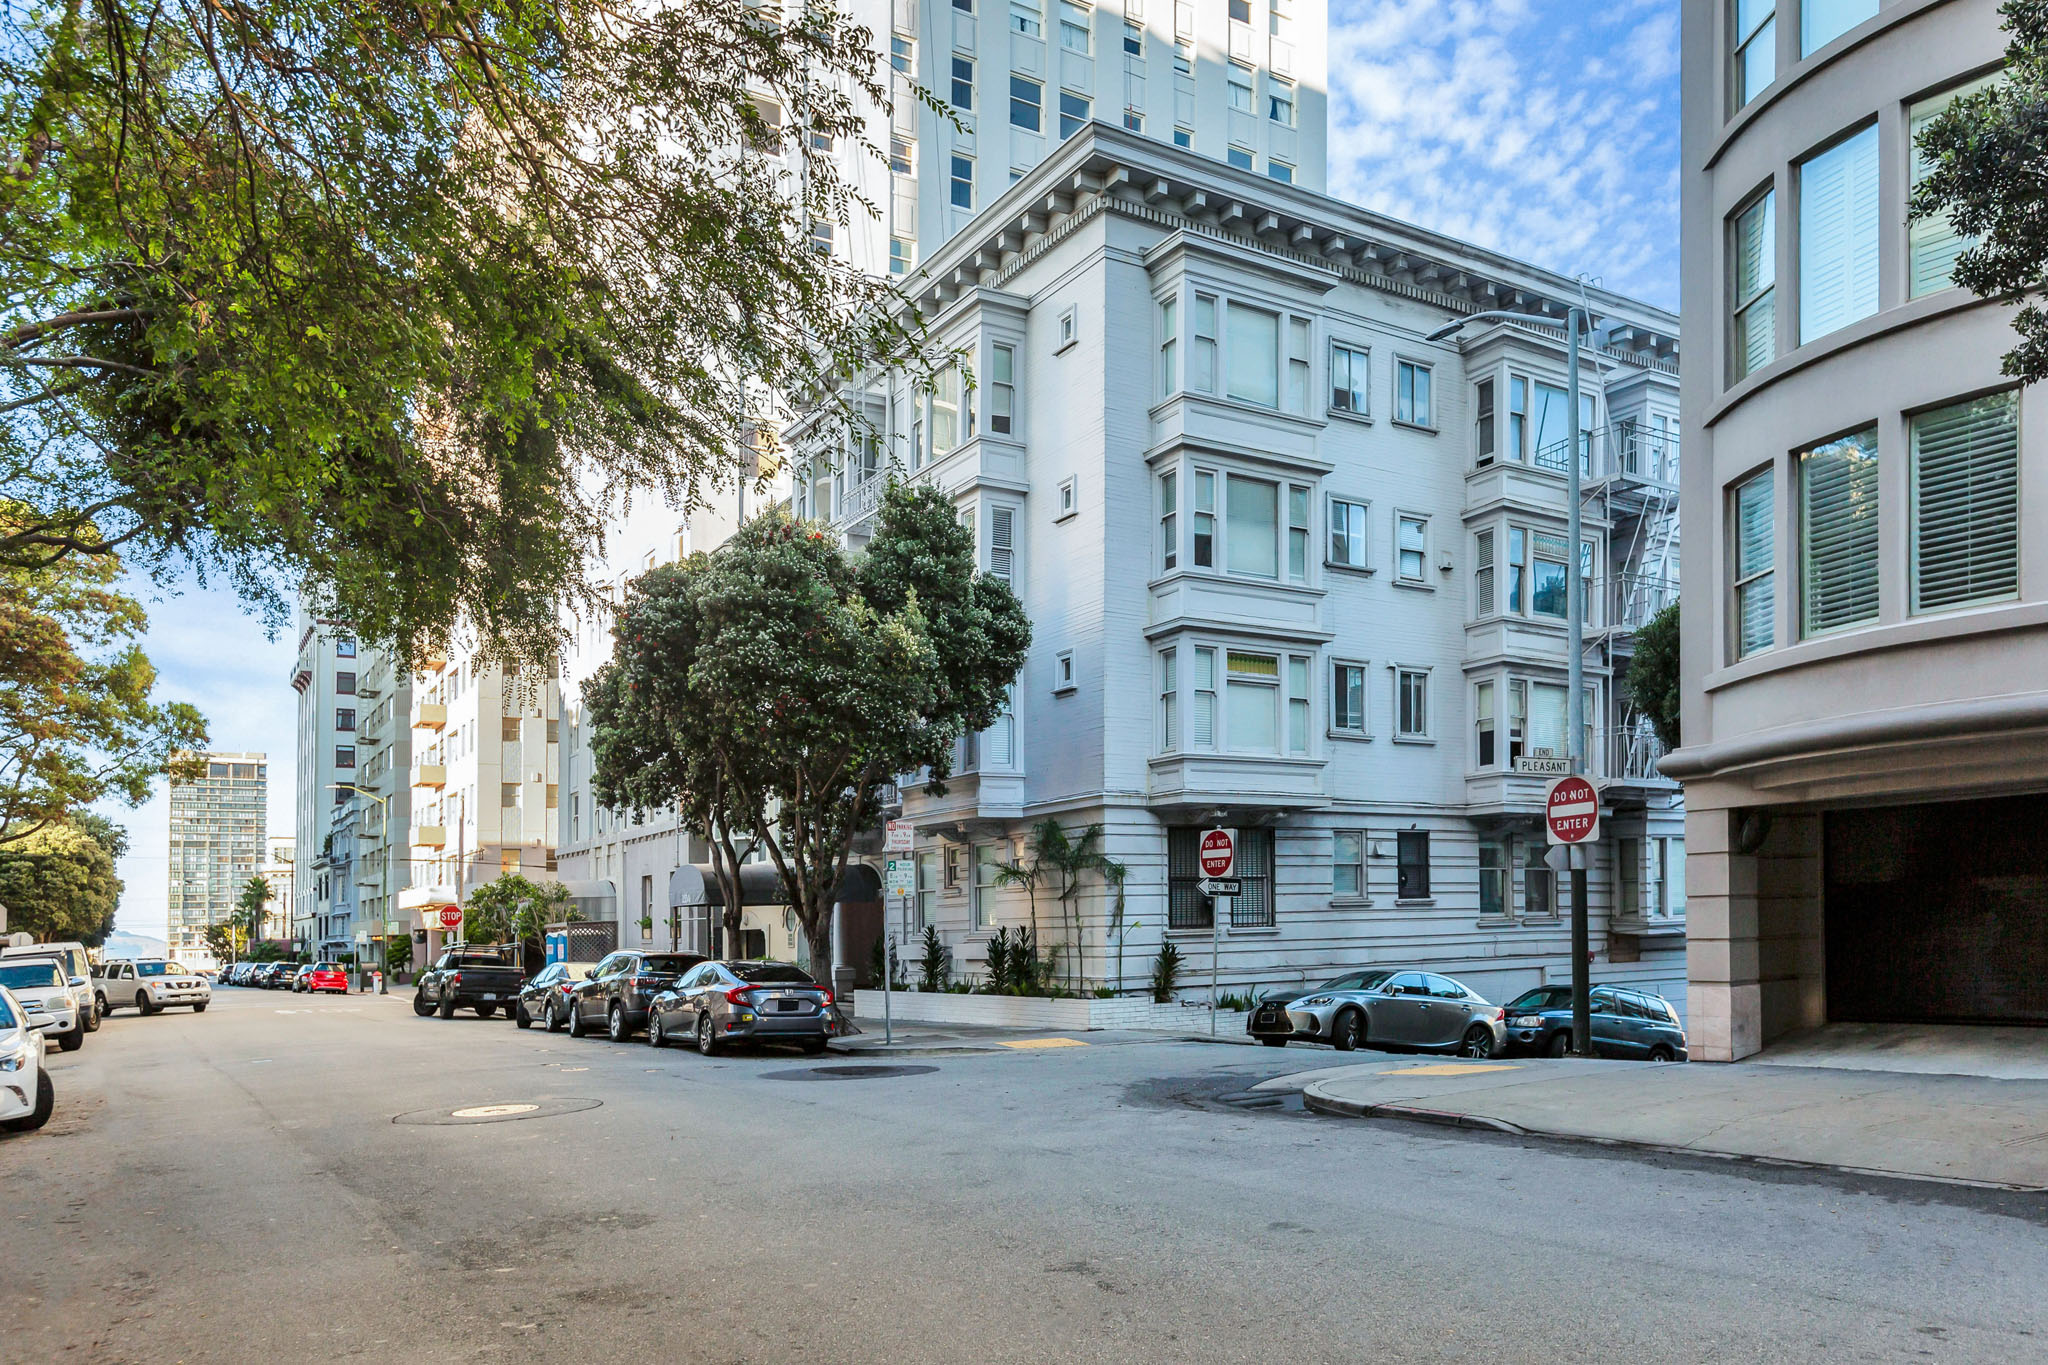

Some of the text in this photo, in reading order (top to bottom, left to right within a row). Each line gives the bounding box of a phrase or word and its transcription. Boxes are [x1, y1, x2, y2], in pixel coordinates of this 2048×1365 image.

[1522, 761, 1567, 772] PLEASANT
[1554, 788, 1589, 802] DO NOT
[1557, 818, 1588, 830] ENTER
[1206, 860, 1225, 868] ENTER
[1208, 882, 1238, 891] ONE WAY
[442, 912, 461, 920] STOP
